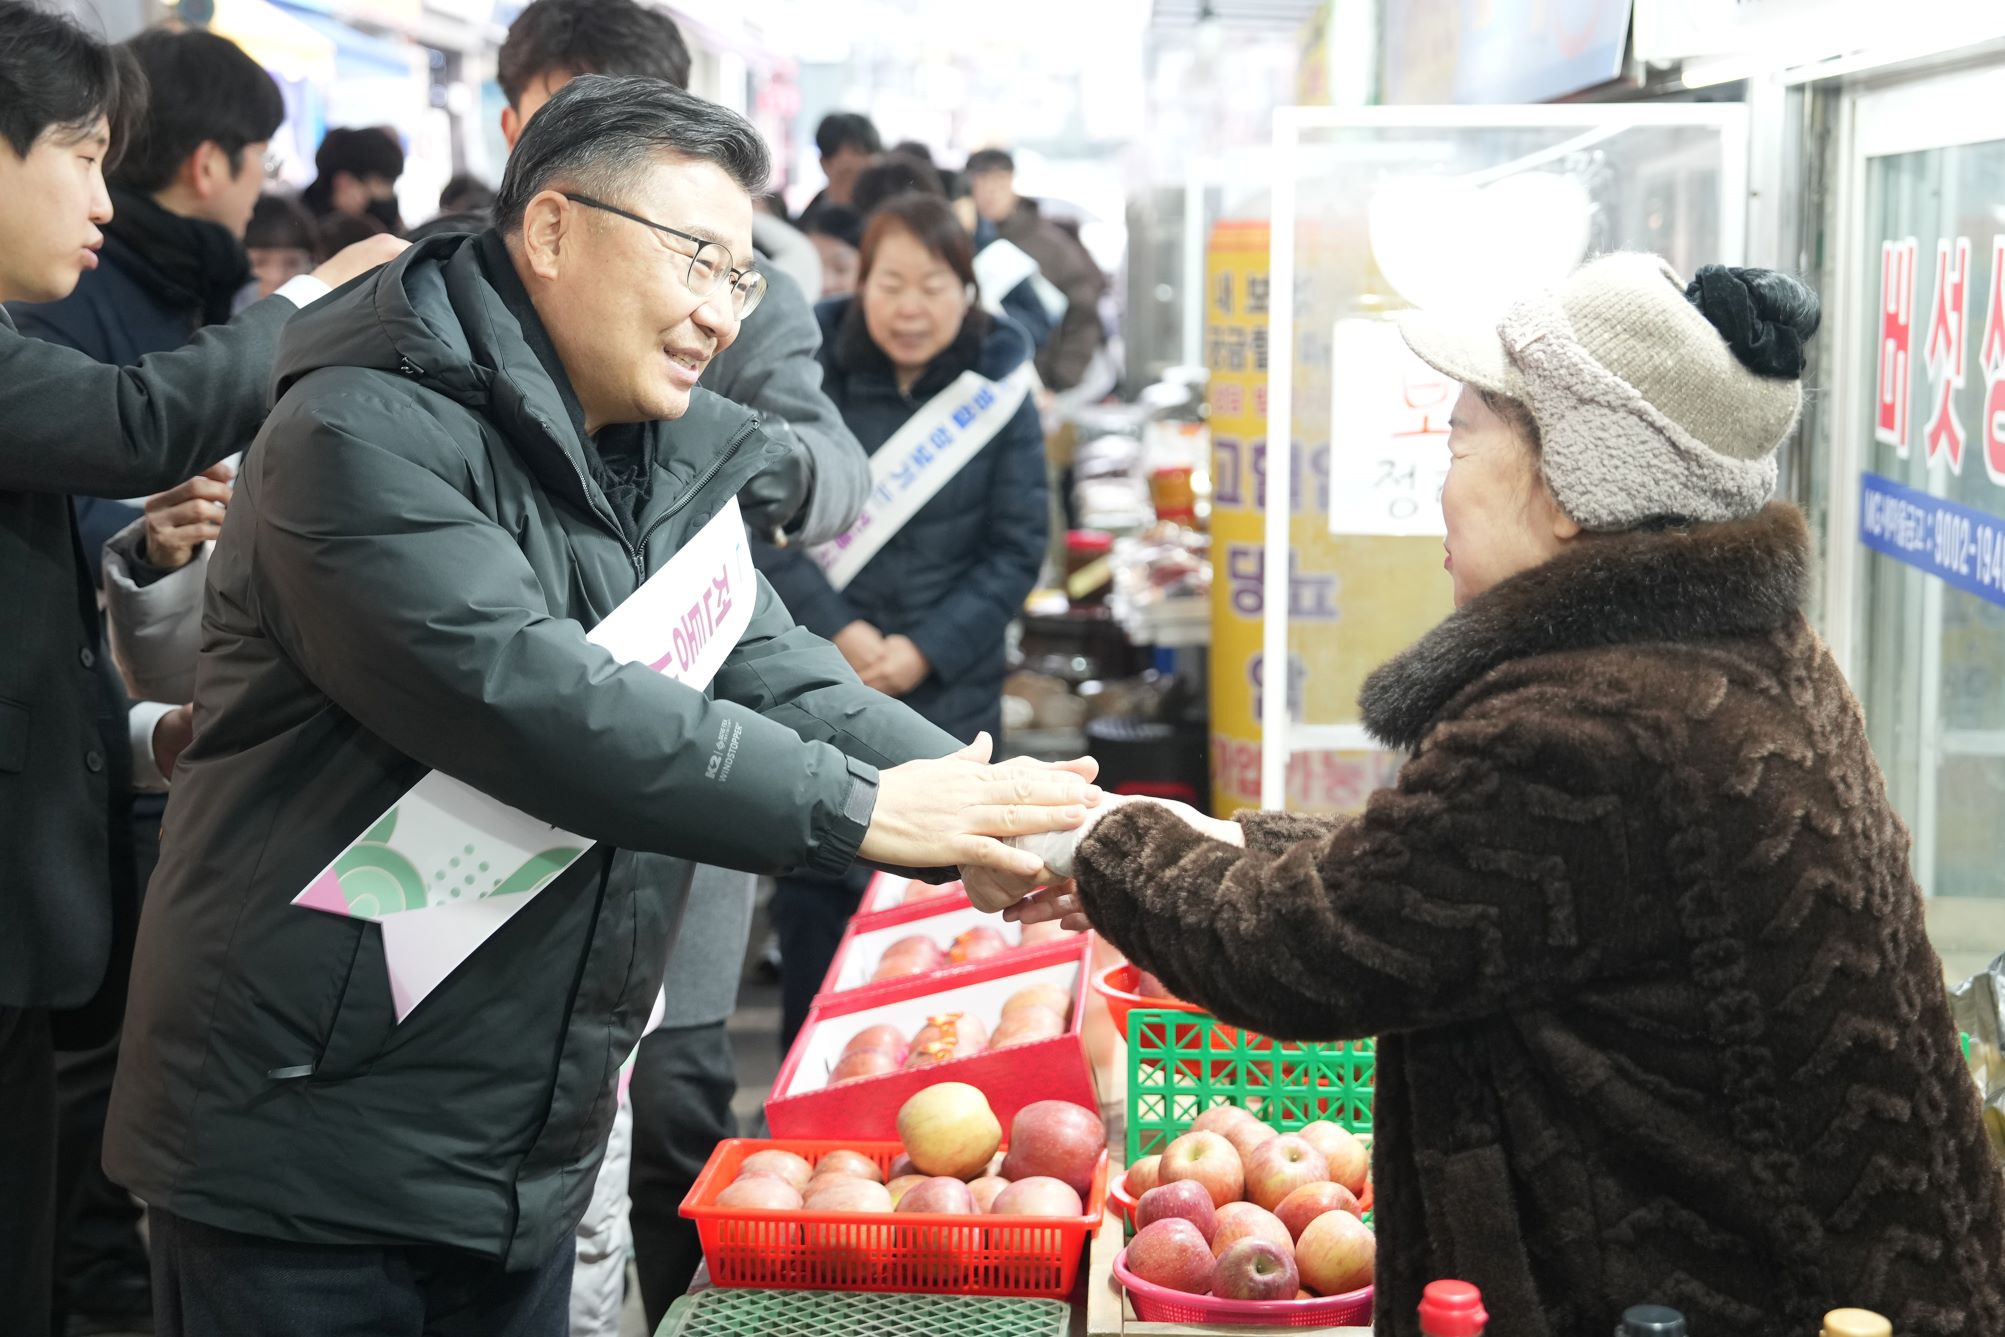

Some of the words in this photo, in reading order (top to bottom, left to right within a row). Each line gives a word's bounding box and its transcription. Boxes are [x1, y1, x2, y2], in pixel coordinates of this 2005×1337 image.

[648, 562, 734, 682] 전통
[705, 755, 722, 779] K2
[719, 722, 742, 782] WINDSTOPPER
